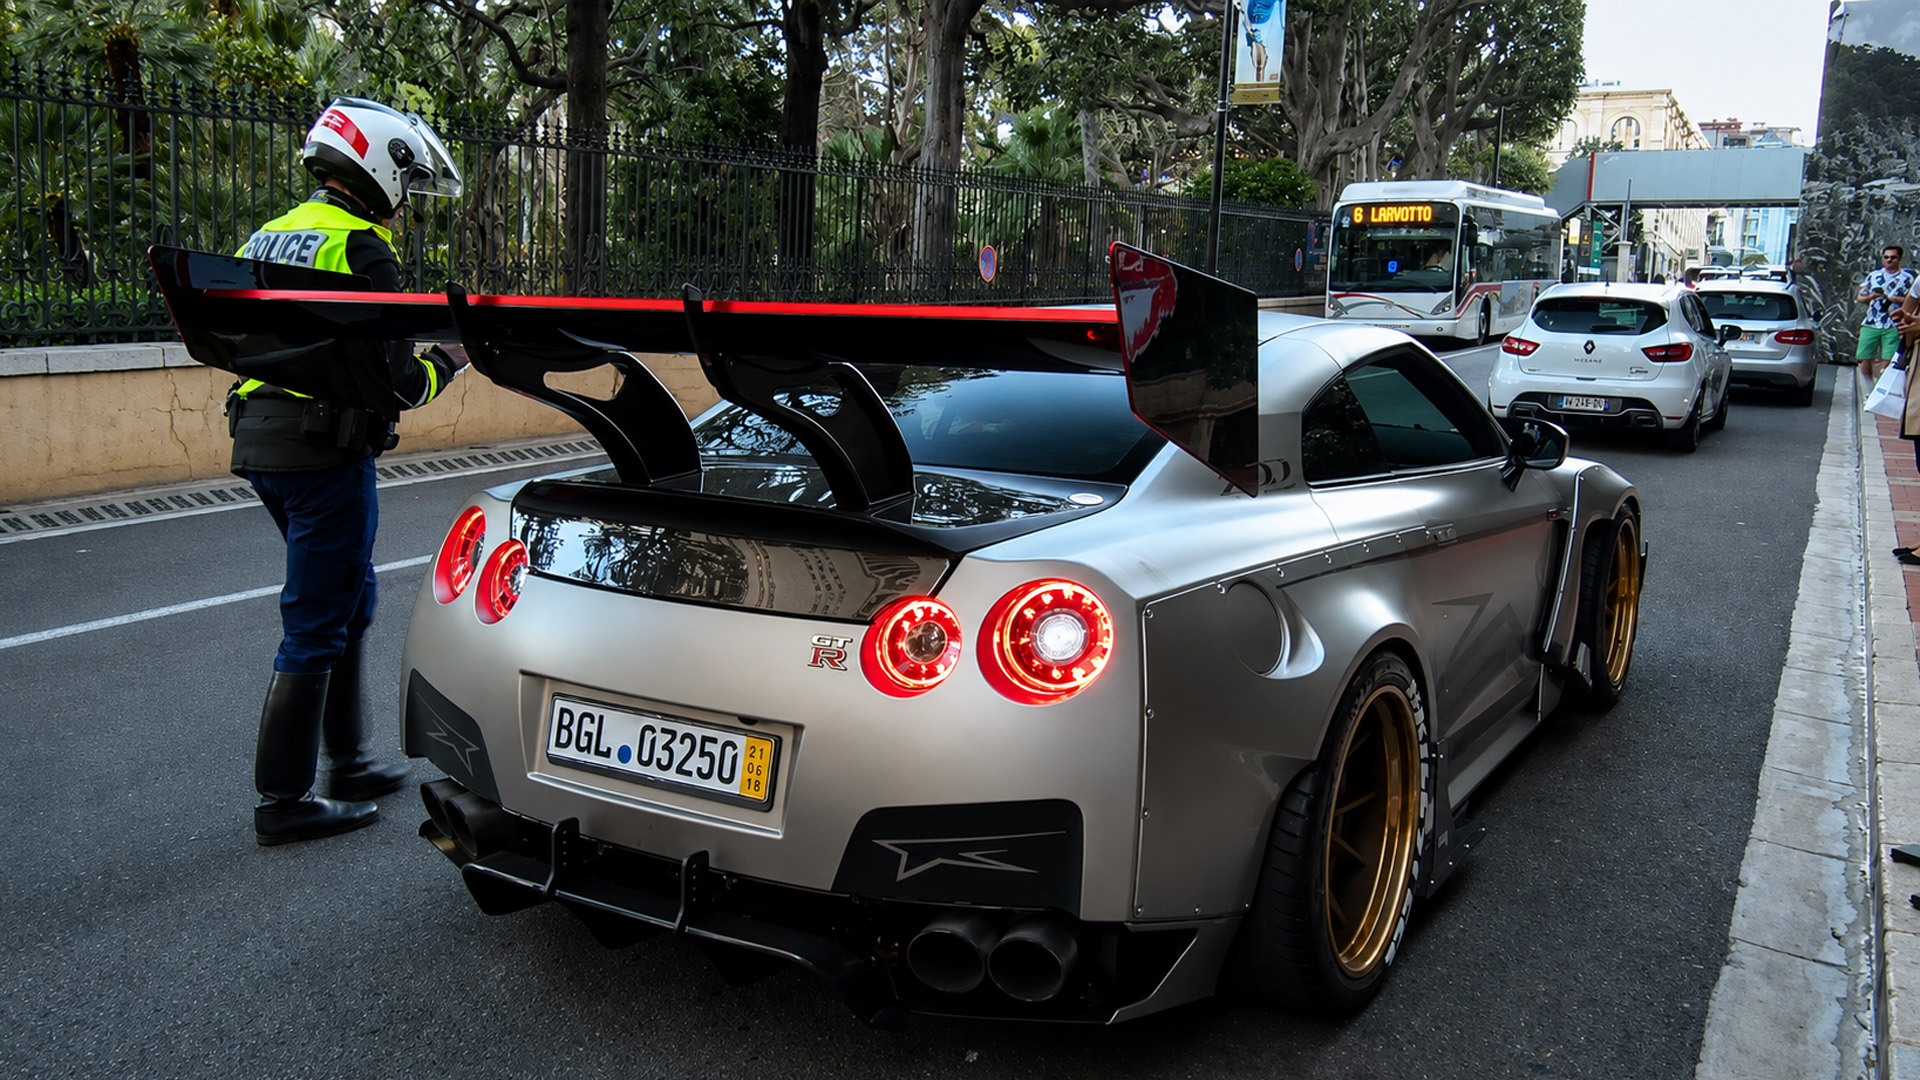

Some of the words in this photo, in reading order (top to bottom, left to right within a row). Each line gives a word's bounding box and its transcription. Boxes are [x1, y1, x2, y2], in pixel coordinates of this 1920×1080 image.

[1353, 206, 1364, 223] 6
[1371, 205, 1432, 223] LARVOTTO
[243, 233, 320, 264] POLICE
[554, 707, 612, 759] BGL
[636, 723, 740, 785] 03250
[749, 745, 764, 760] 21
[747, 762, 762, 776] 06
[746, 777, 761, 792] 18
